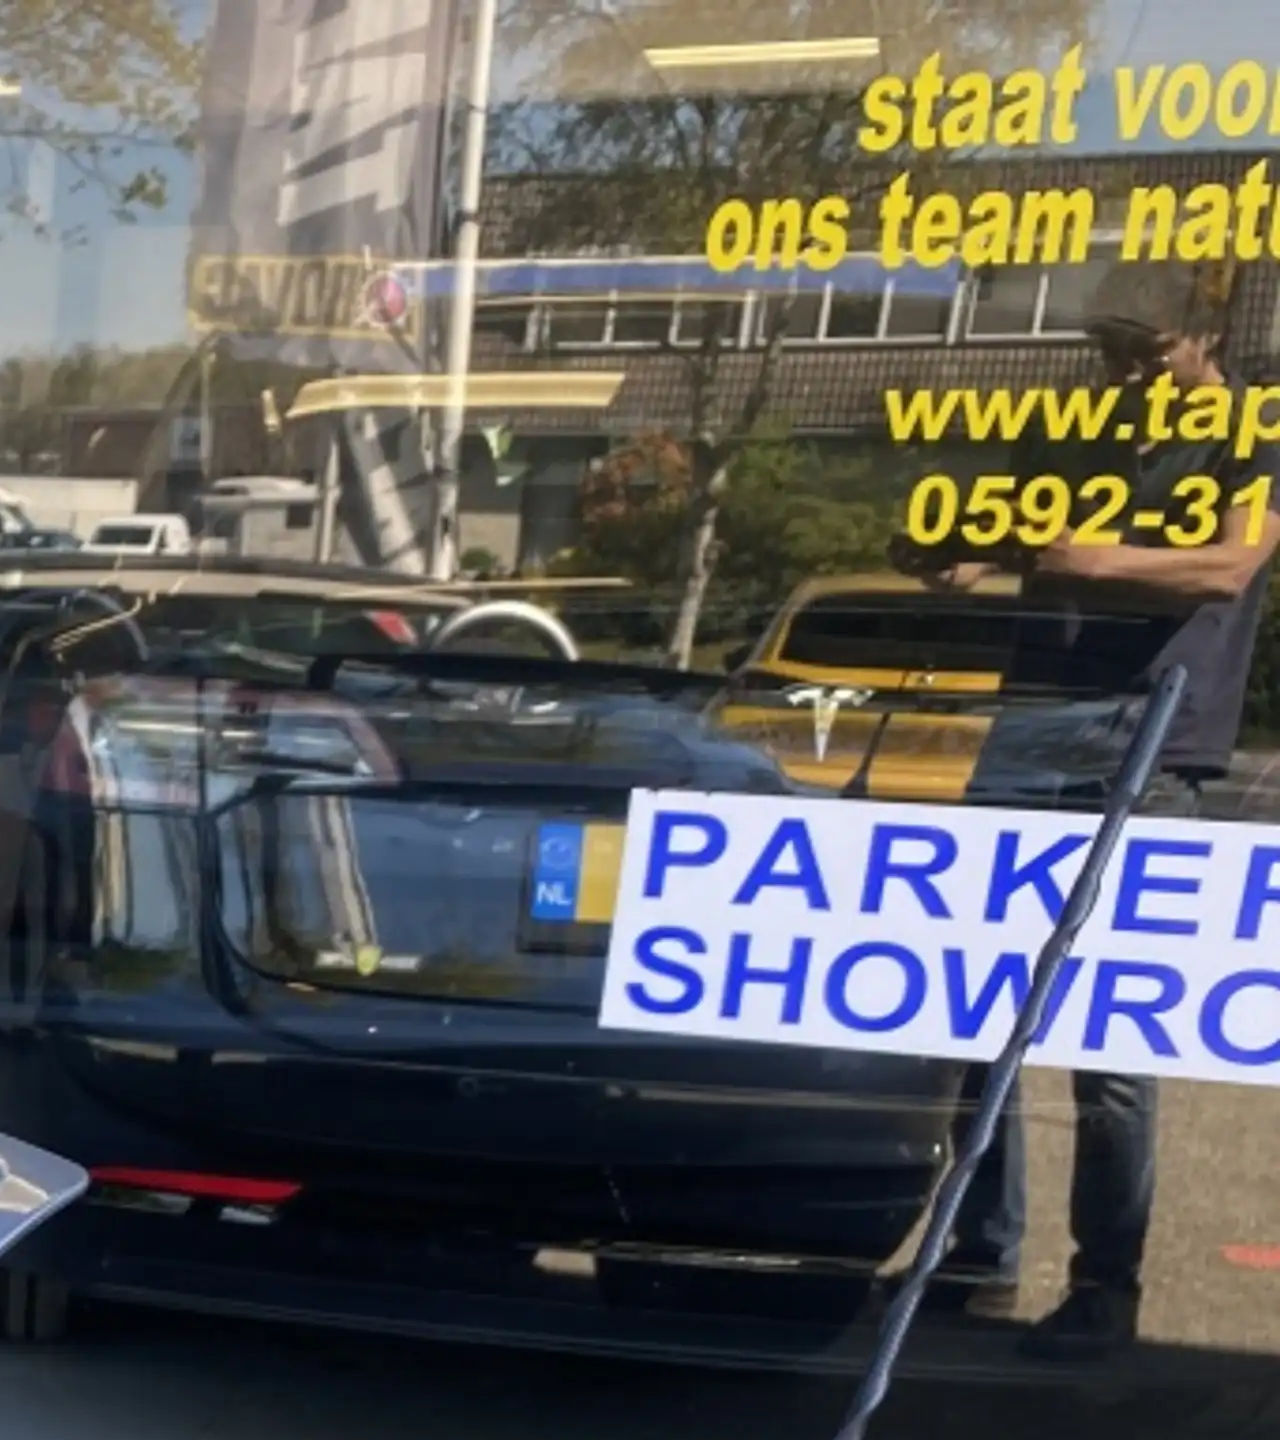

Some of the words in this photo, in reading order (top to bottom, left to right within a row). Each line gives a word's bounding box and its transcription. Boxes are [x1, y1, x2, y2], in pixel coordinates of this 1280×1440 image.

[856, 42, 1086, 153] staat
[706, 195, 850, 274] ons
[878, 170, 1095, 270] team
[1120, 158, 1280, 263] nat
[906, 474, 1273, 549] 0592-31
[536, 881, 573, 906] NL
